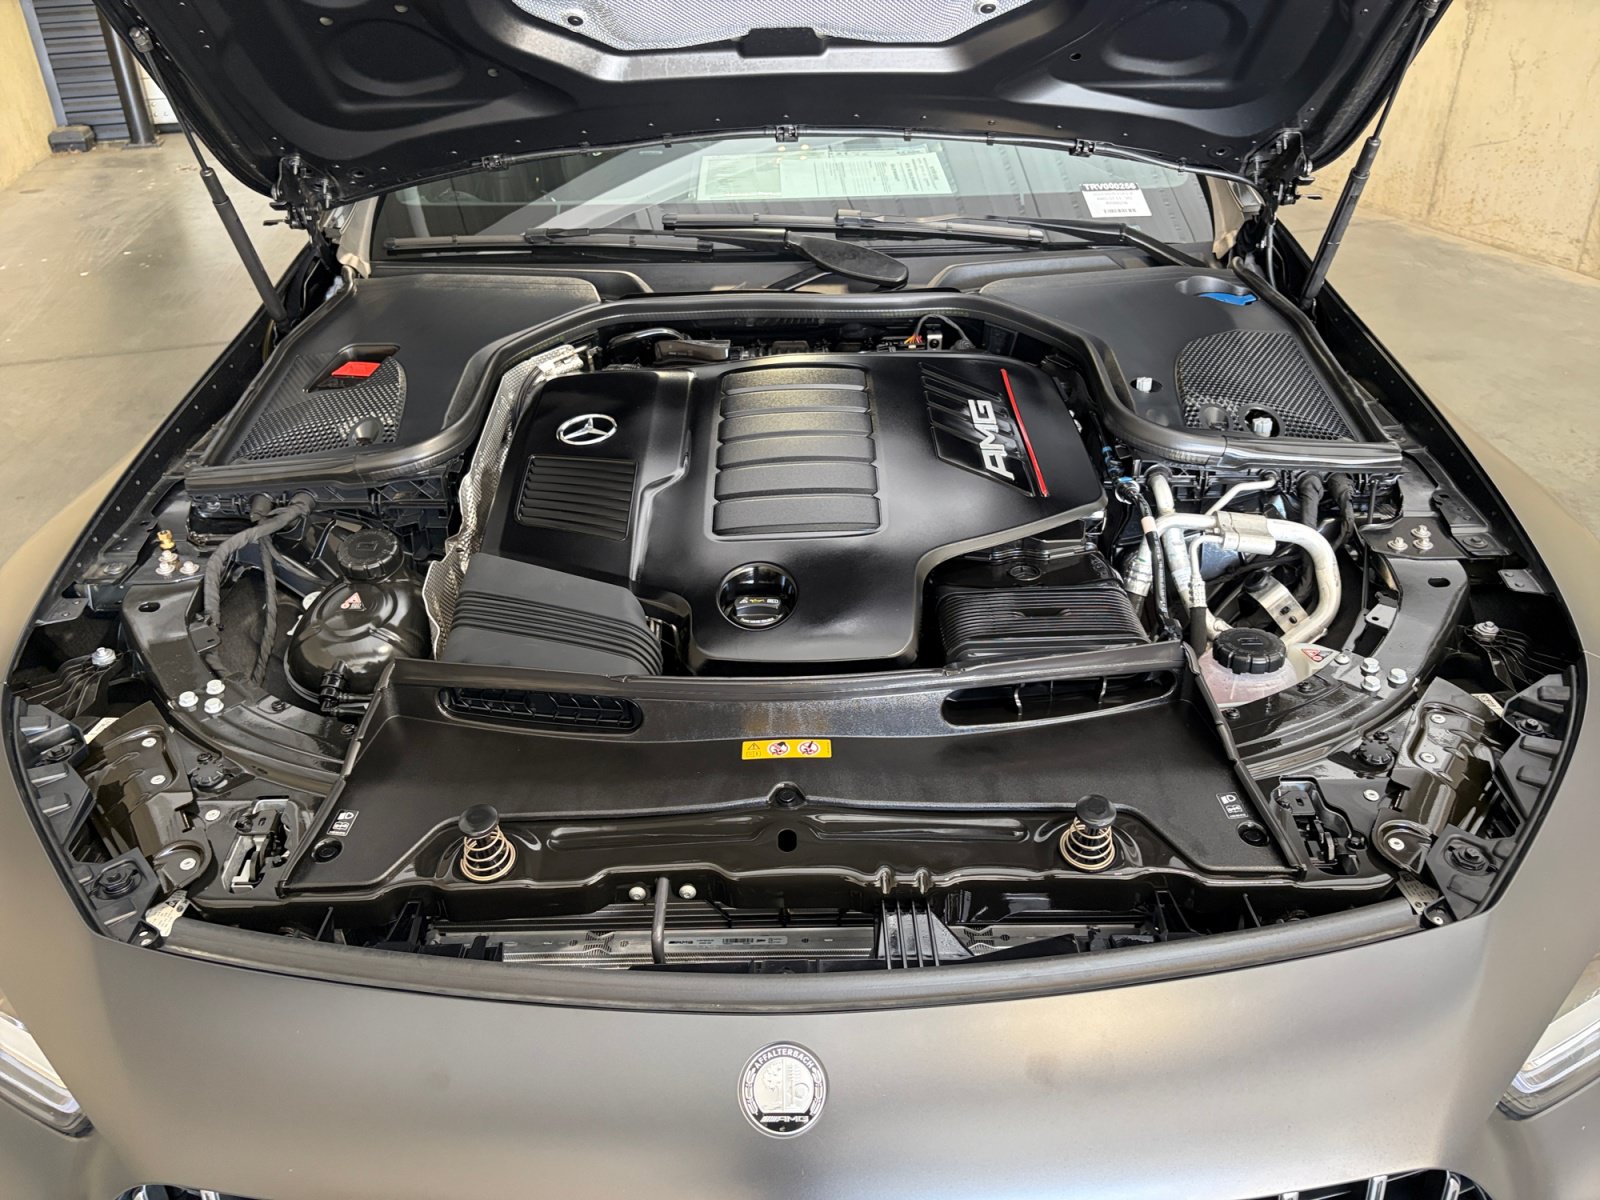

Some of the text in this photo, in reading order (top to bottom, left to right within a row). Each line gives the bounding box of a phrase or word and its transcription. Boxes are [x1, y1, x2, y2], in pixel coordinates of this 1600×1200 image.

[968, 399, 1015, 480] AMG
[754, 1048, 815, 1069] AFFALTERBACH
[775, 1115, 809, 1123] AMG
